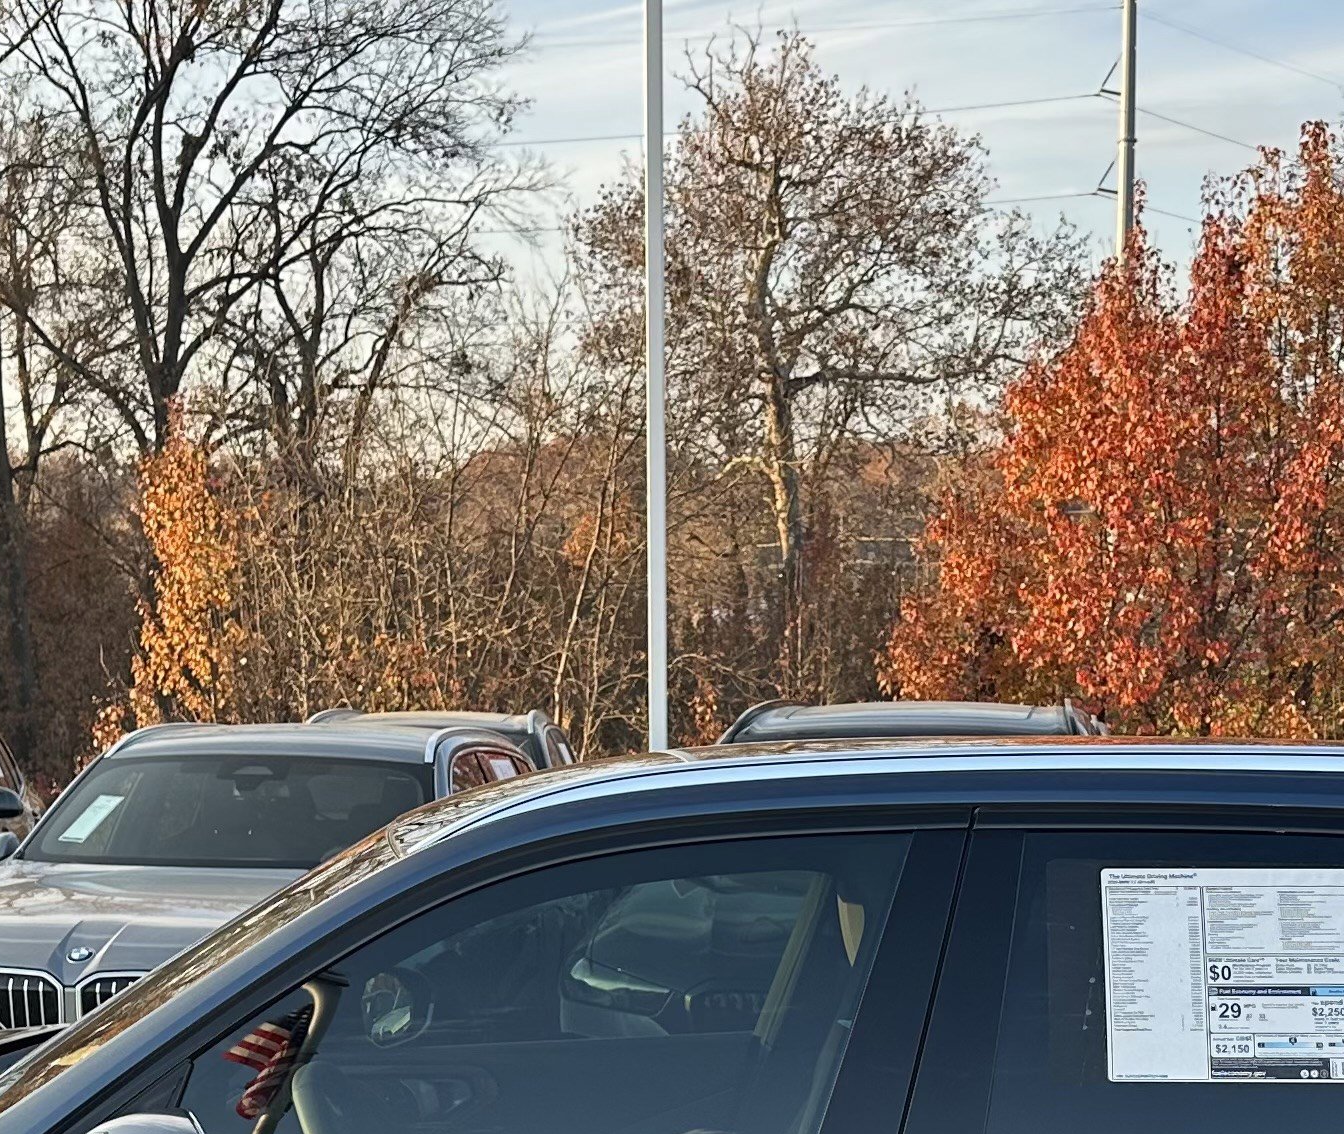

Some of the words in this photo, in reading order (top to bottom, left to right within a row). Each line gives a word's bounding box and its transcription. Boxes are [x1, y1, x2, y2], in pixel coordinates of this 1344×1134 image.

[1209, 964, 1232, 982] $0
[1219, 1003, 1242, 1018] 29
[1216, 1044, 1250, 1054] $2,150
